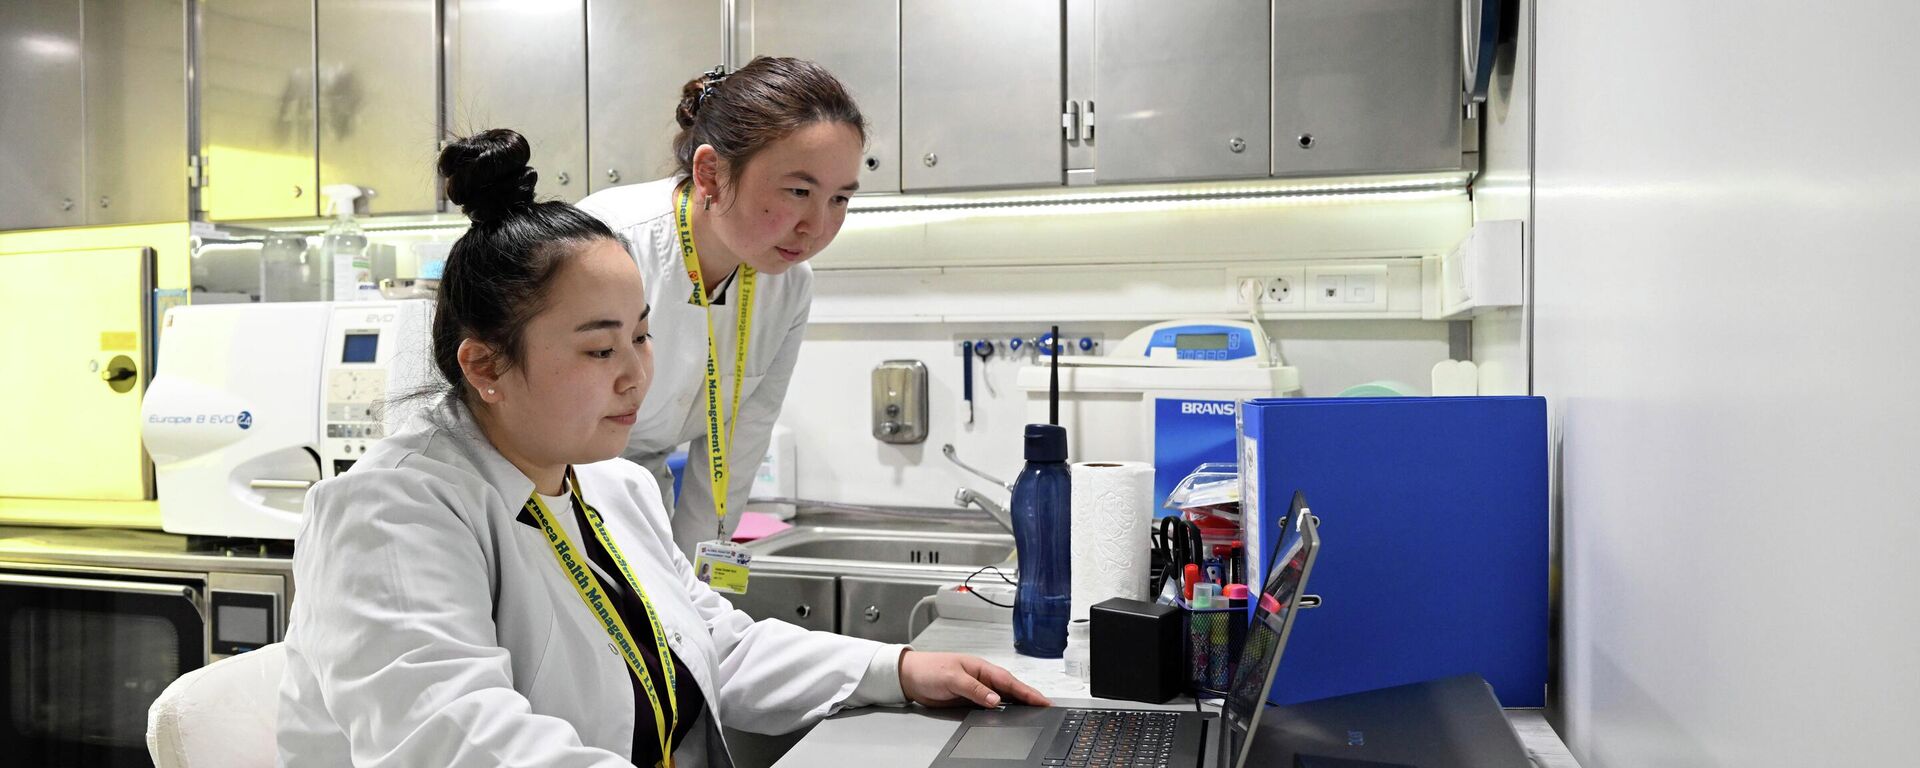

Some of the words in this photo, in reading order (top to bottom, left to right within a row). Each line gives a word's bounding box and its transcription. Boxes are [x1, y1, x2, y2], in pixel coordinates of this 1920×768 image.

[680, 181, 691, 228] agement
[681, 230, 693, 257] LLC.
[693, 282, 702, 305] Nor
[148, 414, 192, 425] Europa
[237, 412, 252, 428] 24
[708, 379, 721, 454] Management
[1181, 402, 1236, 416] BRANS
[713, 456, 723, 482] LLC.
[526, 498, 558, 542] rmeca
[555, 540, 590, 590] Health
[586, 587, 645, 675] Management
